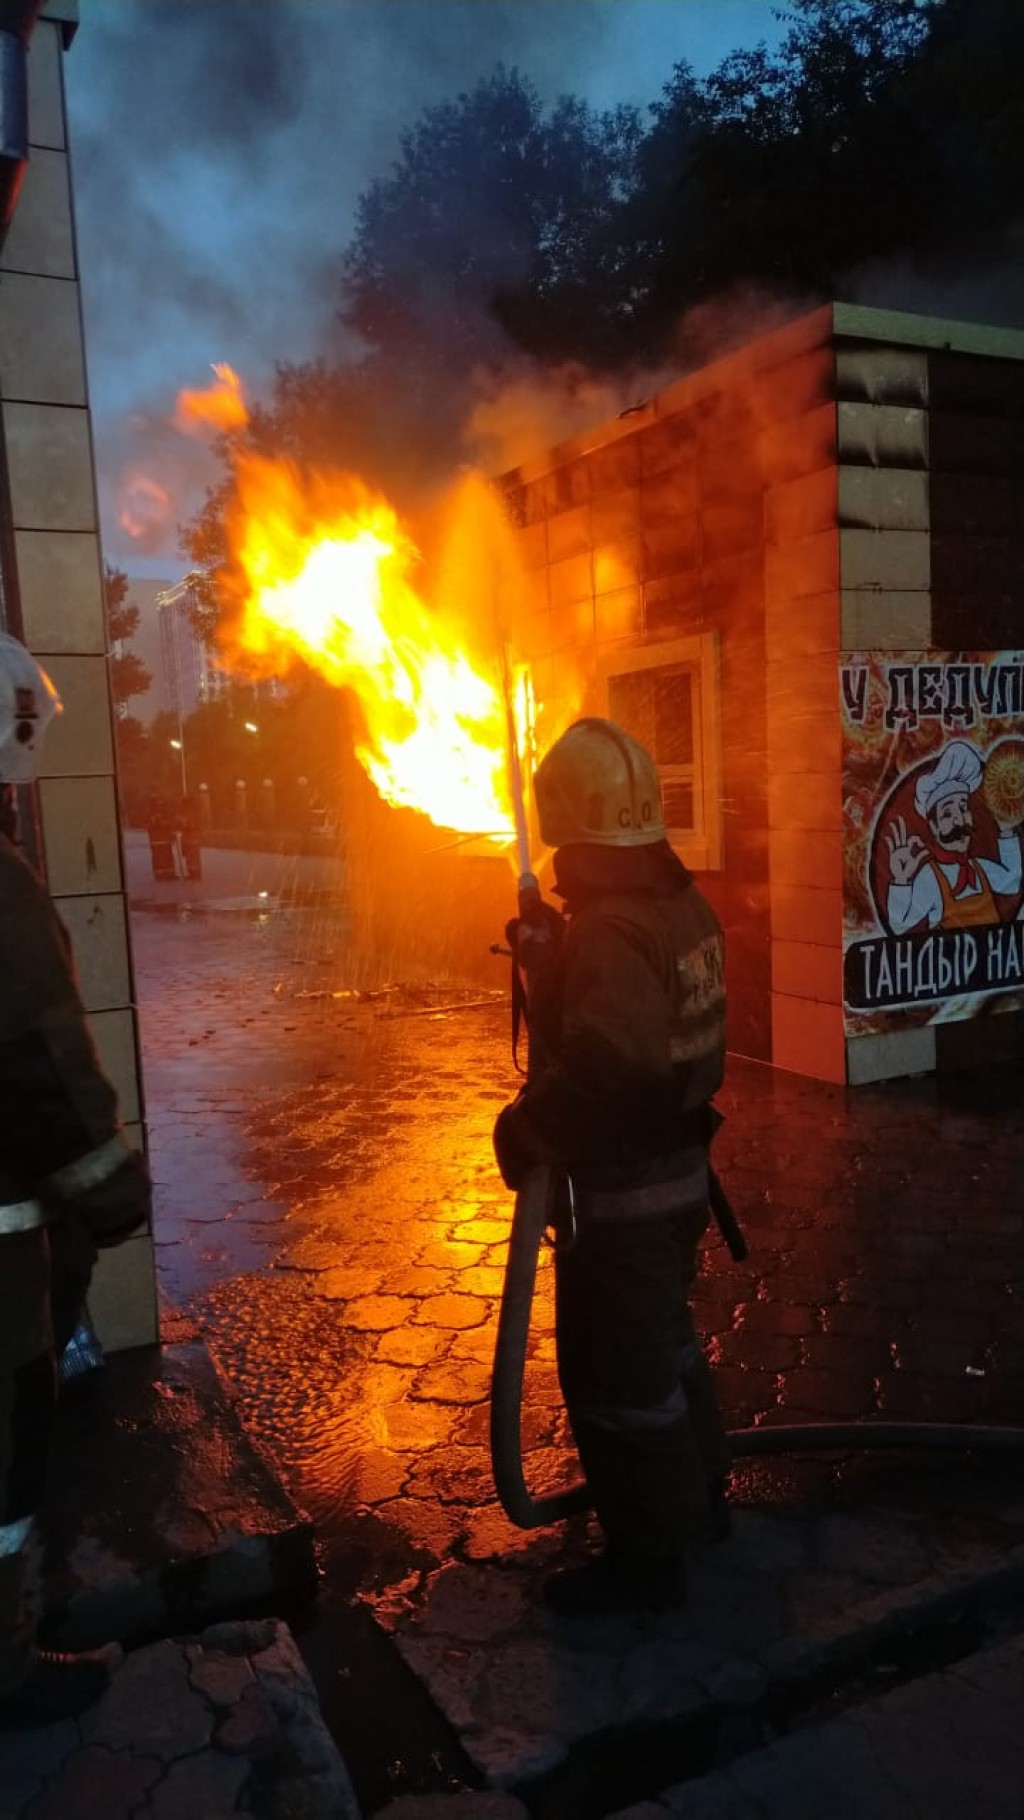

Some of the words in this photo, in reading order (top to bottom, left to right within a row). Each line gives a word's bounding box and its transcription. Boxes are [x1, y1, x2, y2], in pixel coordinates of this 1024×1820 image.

[840, 666, 868, 722] У
[885, 664, 1024, 731] ДЕДУЛ
[860, 933, 978, 1000] ТАНДЫР
[987, 924, 1024, 981] НА
